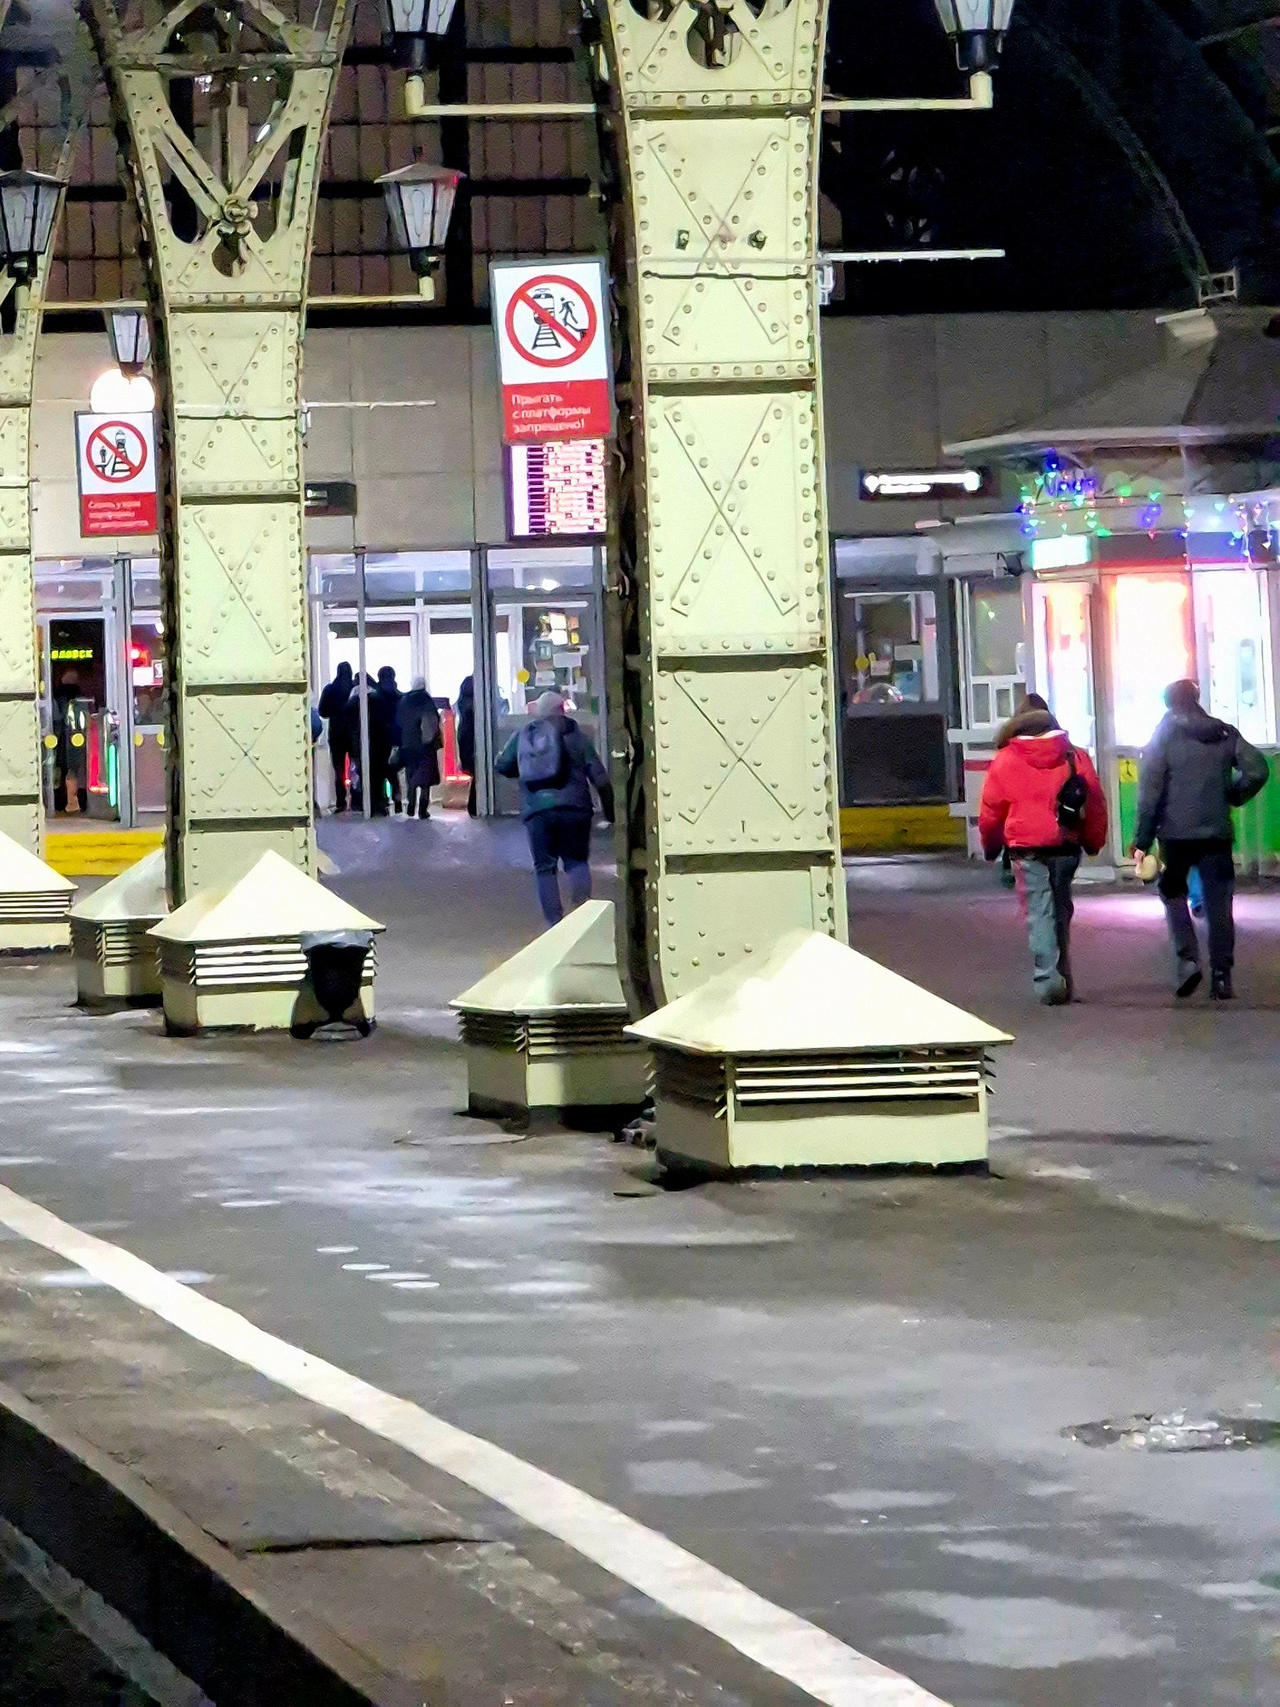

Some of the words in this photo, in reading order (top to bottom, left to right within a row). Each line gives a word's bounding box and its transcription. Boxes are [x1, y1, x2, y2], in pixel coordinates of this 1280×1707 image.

[511, 394, 563, 405] Прыгать
[512, 410, 519, 419] с
[521, 406, 591, 421] платформы
[512, 418, 585, 435] запрещено!
